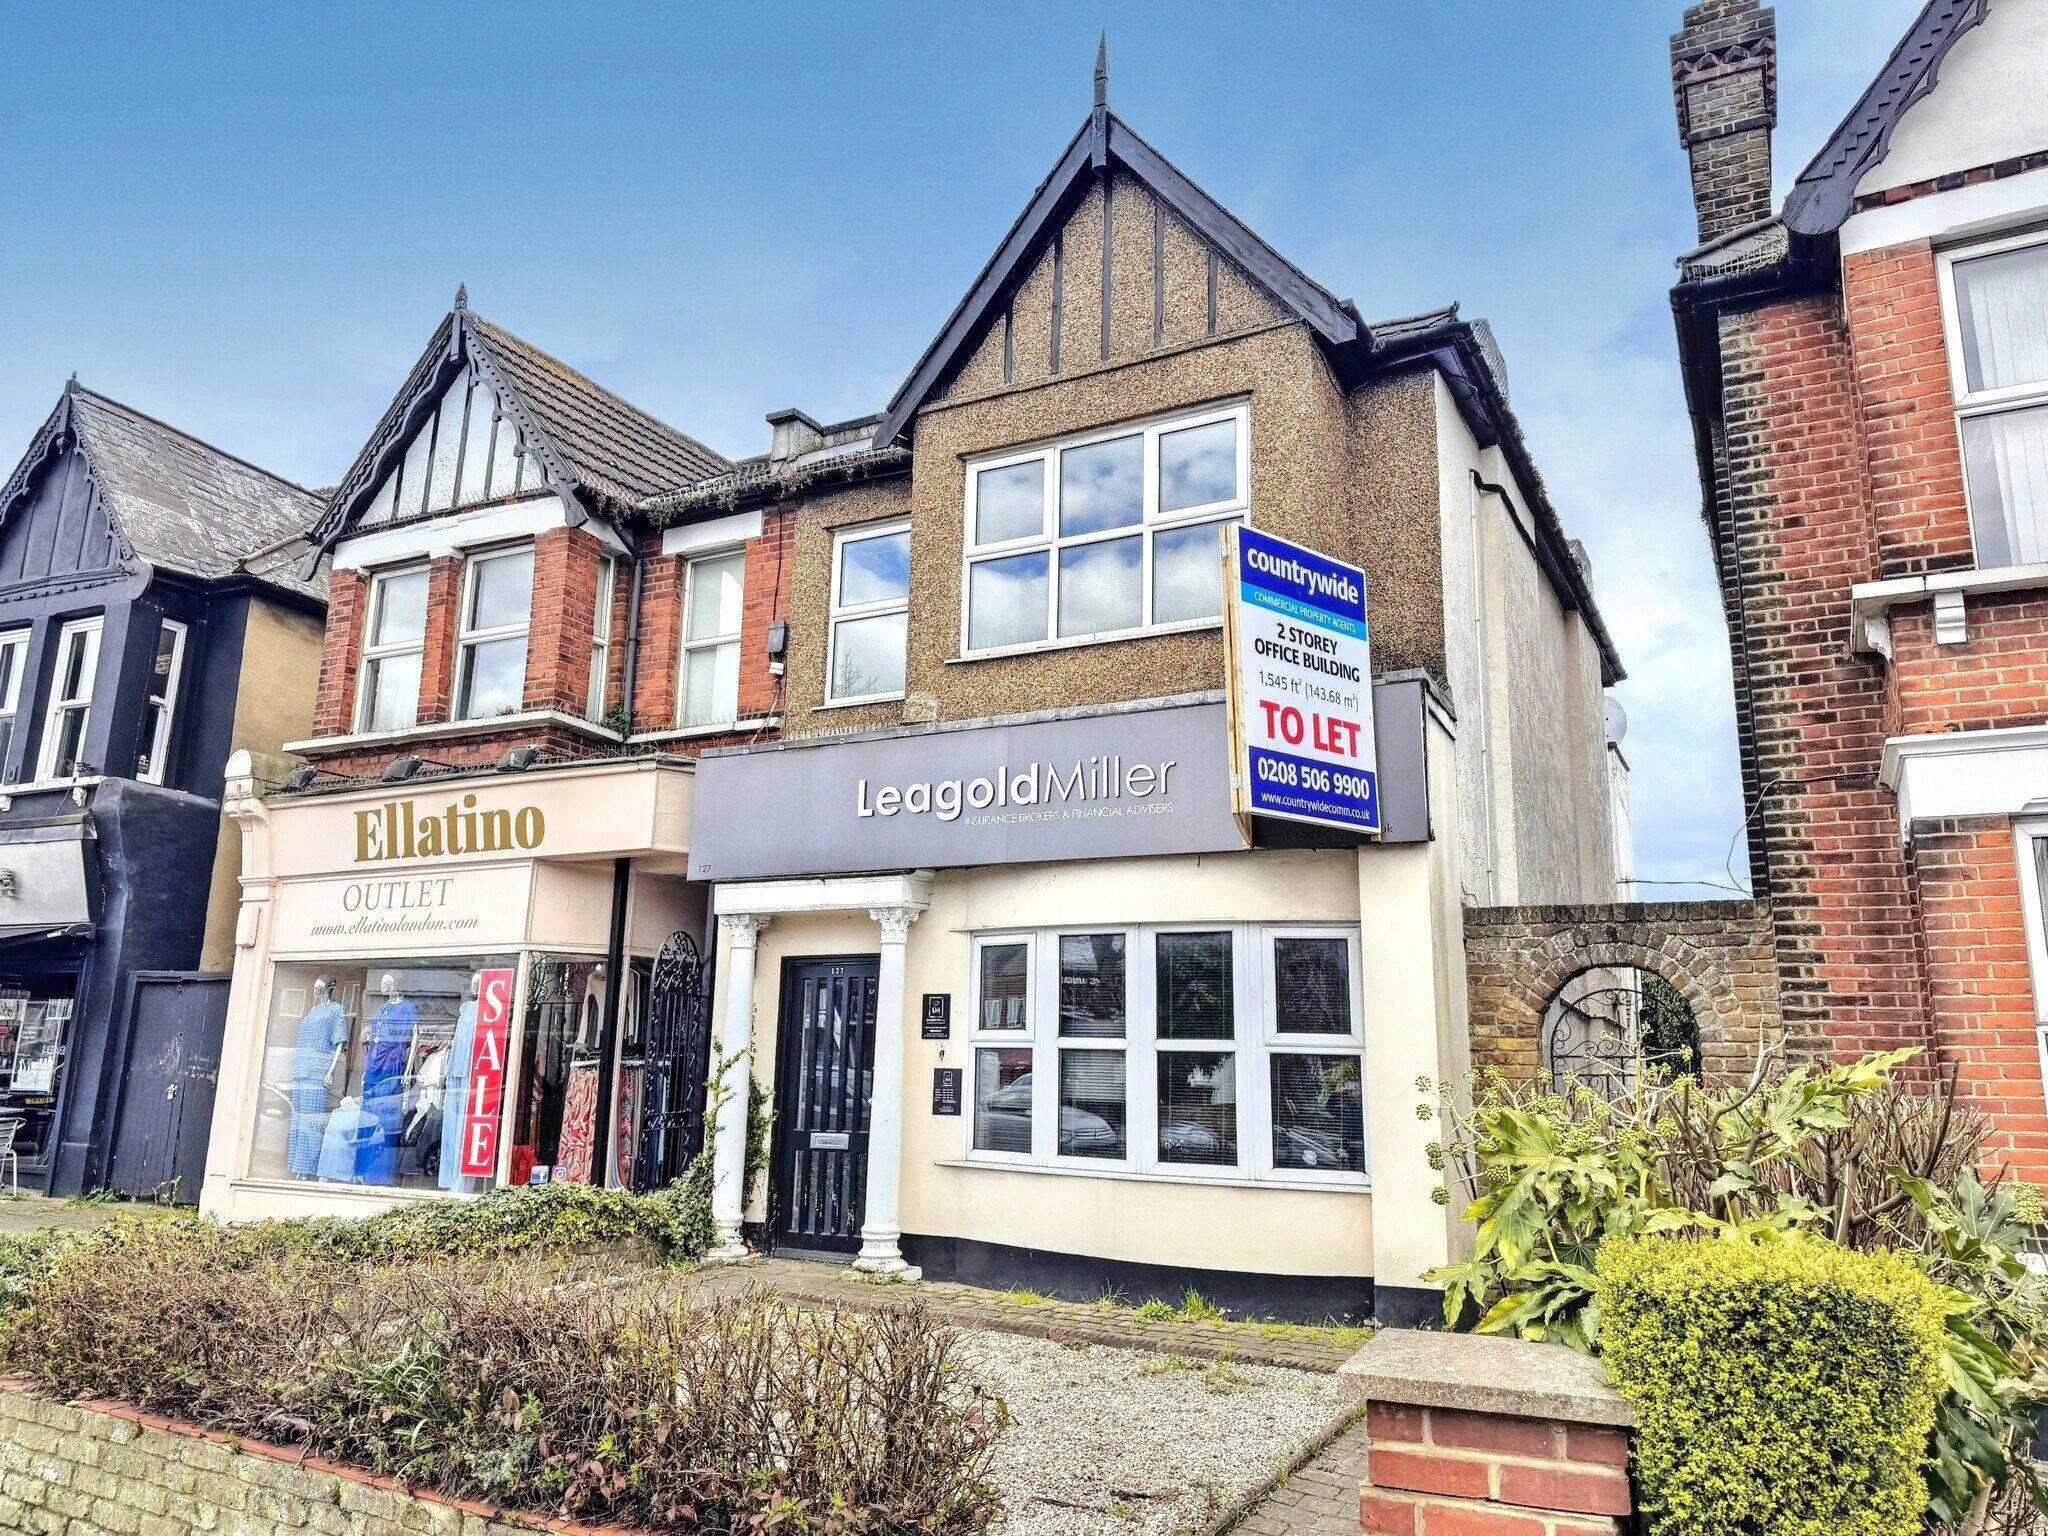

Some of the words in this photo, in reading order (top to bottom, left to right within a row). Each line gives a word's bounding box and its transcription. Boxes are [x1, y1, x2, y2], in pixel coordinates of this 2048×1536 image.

[1247, 548, 1359, 605] countrywide
[1254, 591, 1299, 615] COMMERCIAL
[1300, 606, 1332, 625] PROPERTY
[1333, 617, 1356, 633] AGENTS
[1277, 622, 1286, 640] 2
[1289, 626, 1338, 655] STOREY
[1254, 637, 1300, 665] OFFICE
[1303, 652, 1360, 683] BUILDING
[1259, 670, 1288, 691] 1,545
[1305, 682, 1341, 705] (143.68
[1259, 699, 1304, 745] TO
[1312, 713, 1362, 758] LET
[857, 754, 1177, 822] LeagoldMiller
[1257, 756, 1298, 787] 0208
[1301, 765, 1331, 792] 506
[1333, 772, 1370, 800] 9900
[964, 812, 1018, 826] INSURANCE
[1018, 810, 1060, 823] BROKERS
[1062, 809, 1070, 820] &
[1072, 806, 1124, 820] FINANCIAL
[1125, 802, 1174, 816] ADVISERS
[1260, 791, 1371, 820] www.countrywidecomm.co.uk
[353, 793, 546, 863] Ellatino
[698, 864, 712, 873] 127
[342, 877, 454, 912] OUTLET
[310, 912, 480, 937] www.ellatinolondon.com
[831, 967, 845, 975] 127
[467, 979, 506, 1166] SALE
